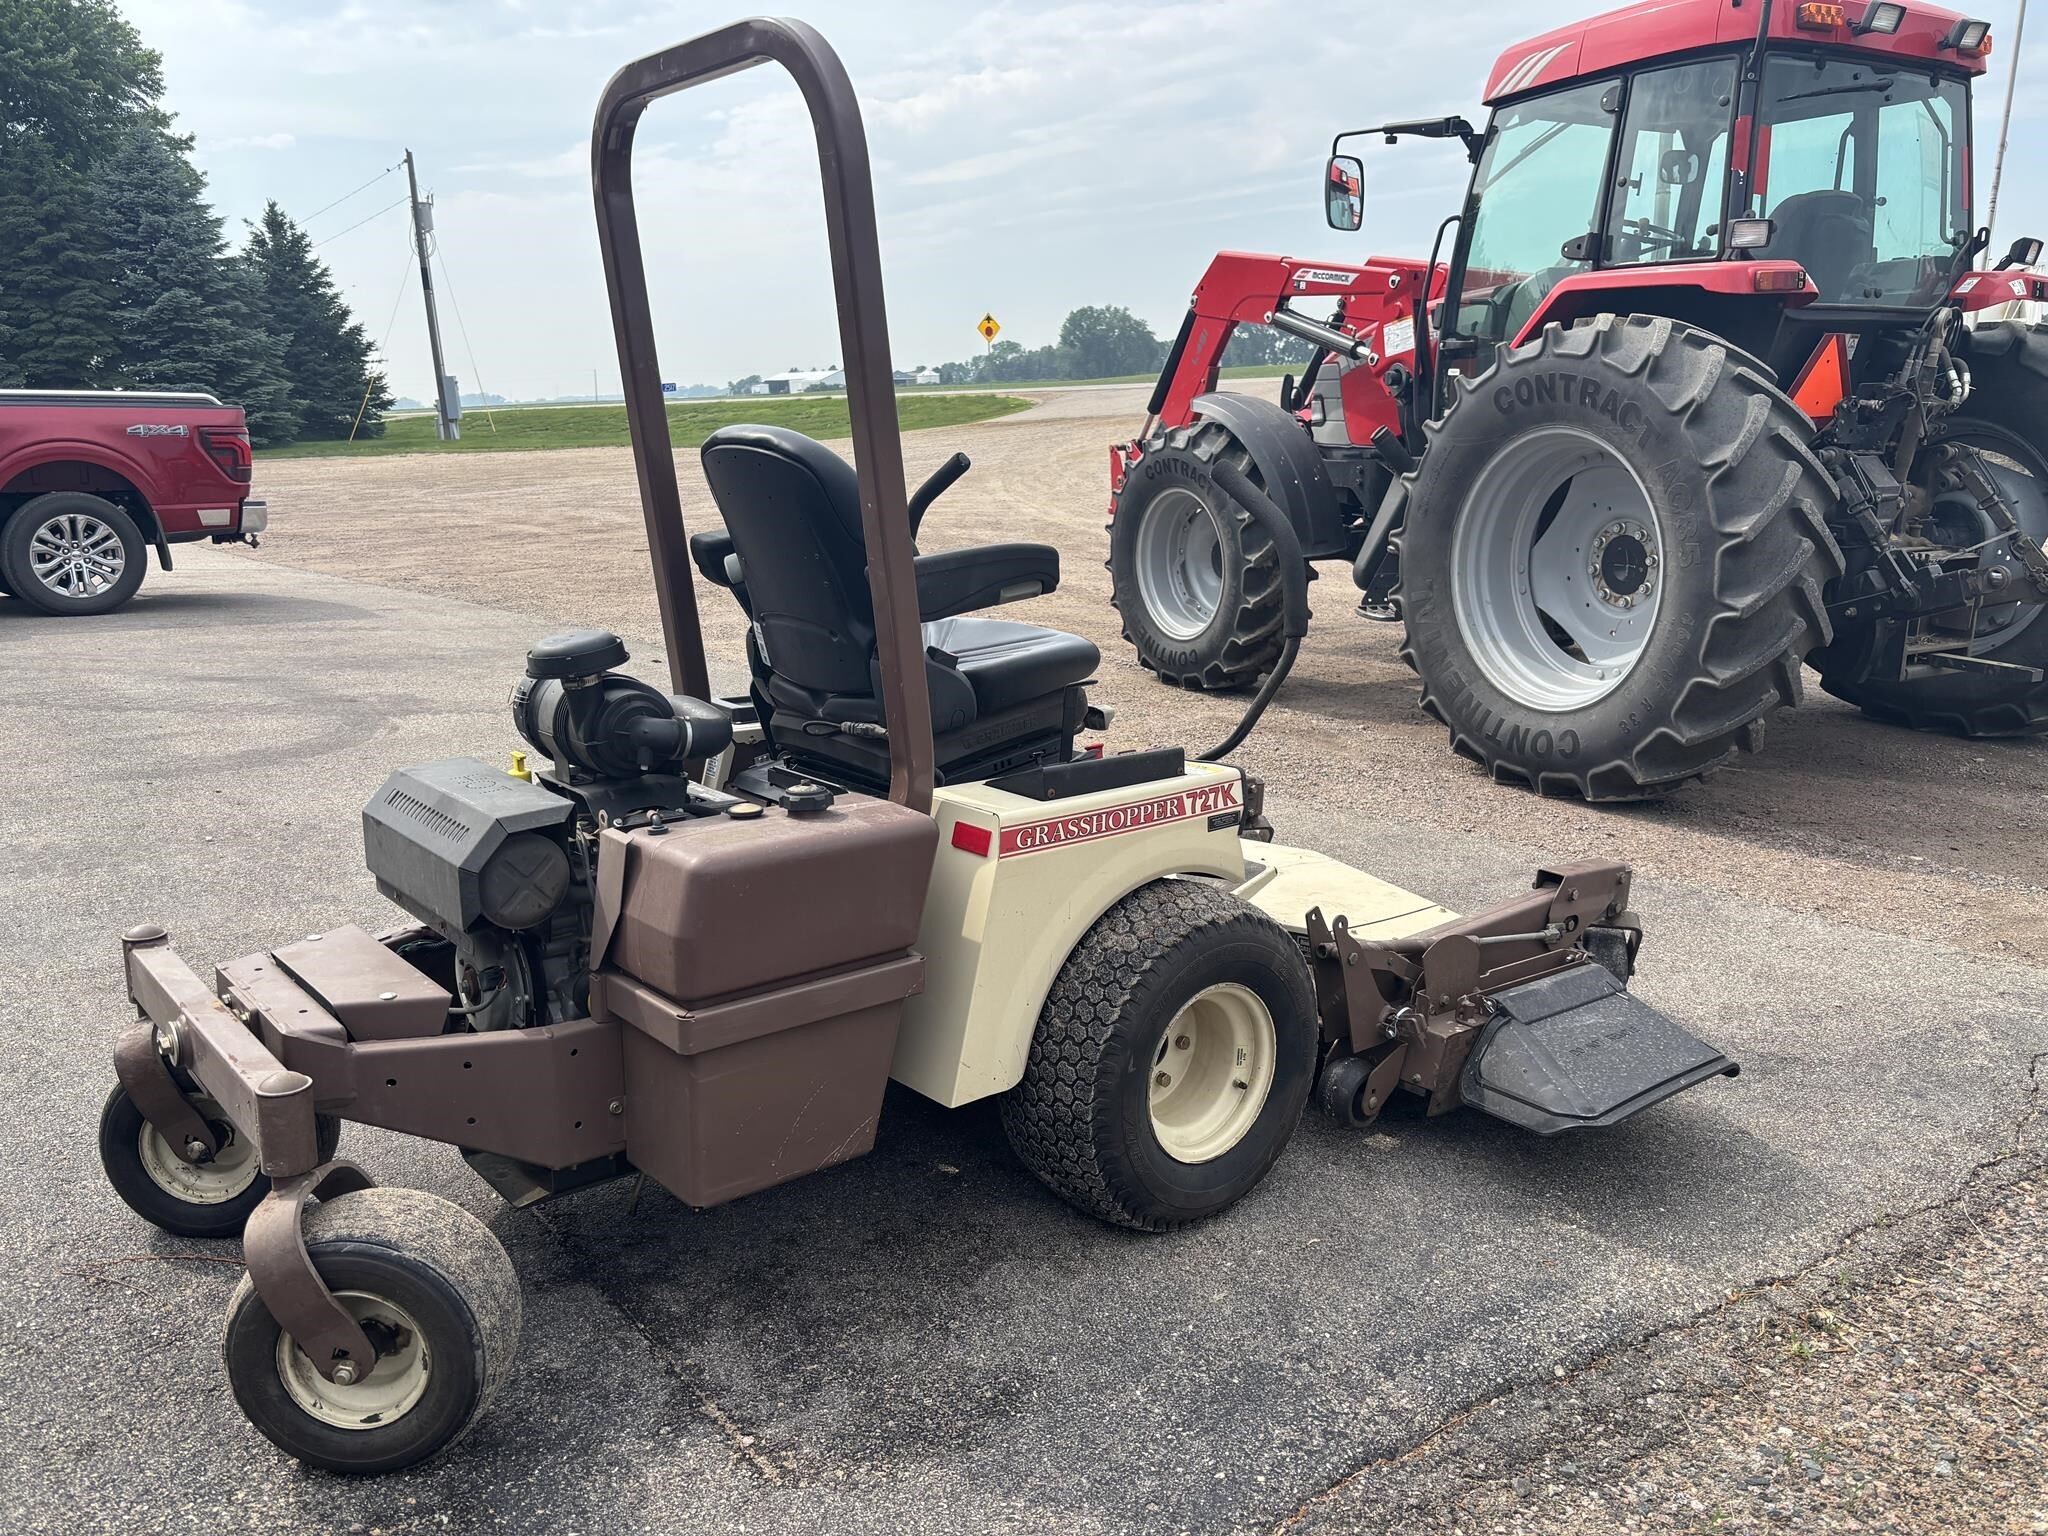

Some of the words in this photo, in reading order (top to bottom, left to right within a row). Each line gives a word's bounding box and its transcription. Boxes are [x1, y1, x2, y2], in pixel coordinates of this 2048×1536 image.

[1493, 371, 1661, 449] CONTRACT
[1015, 799, 1180, 849] GRASSHOPPER
[1186, 782, 1238, 815] 727K
